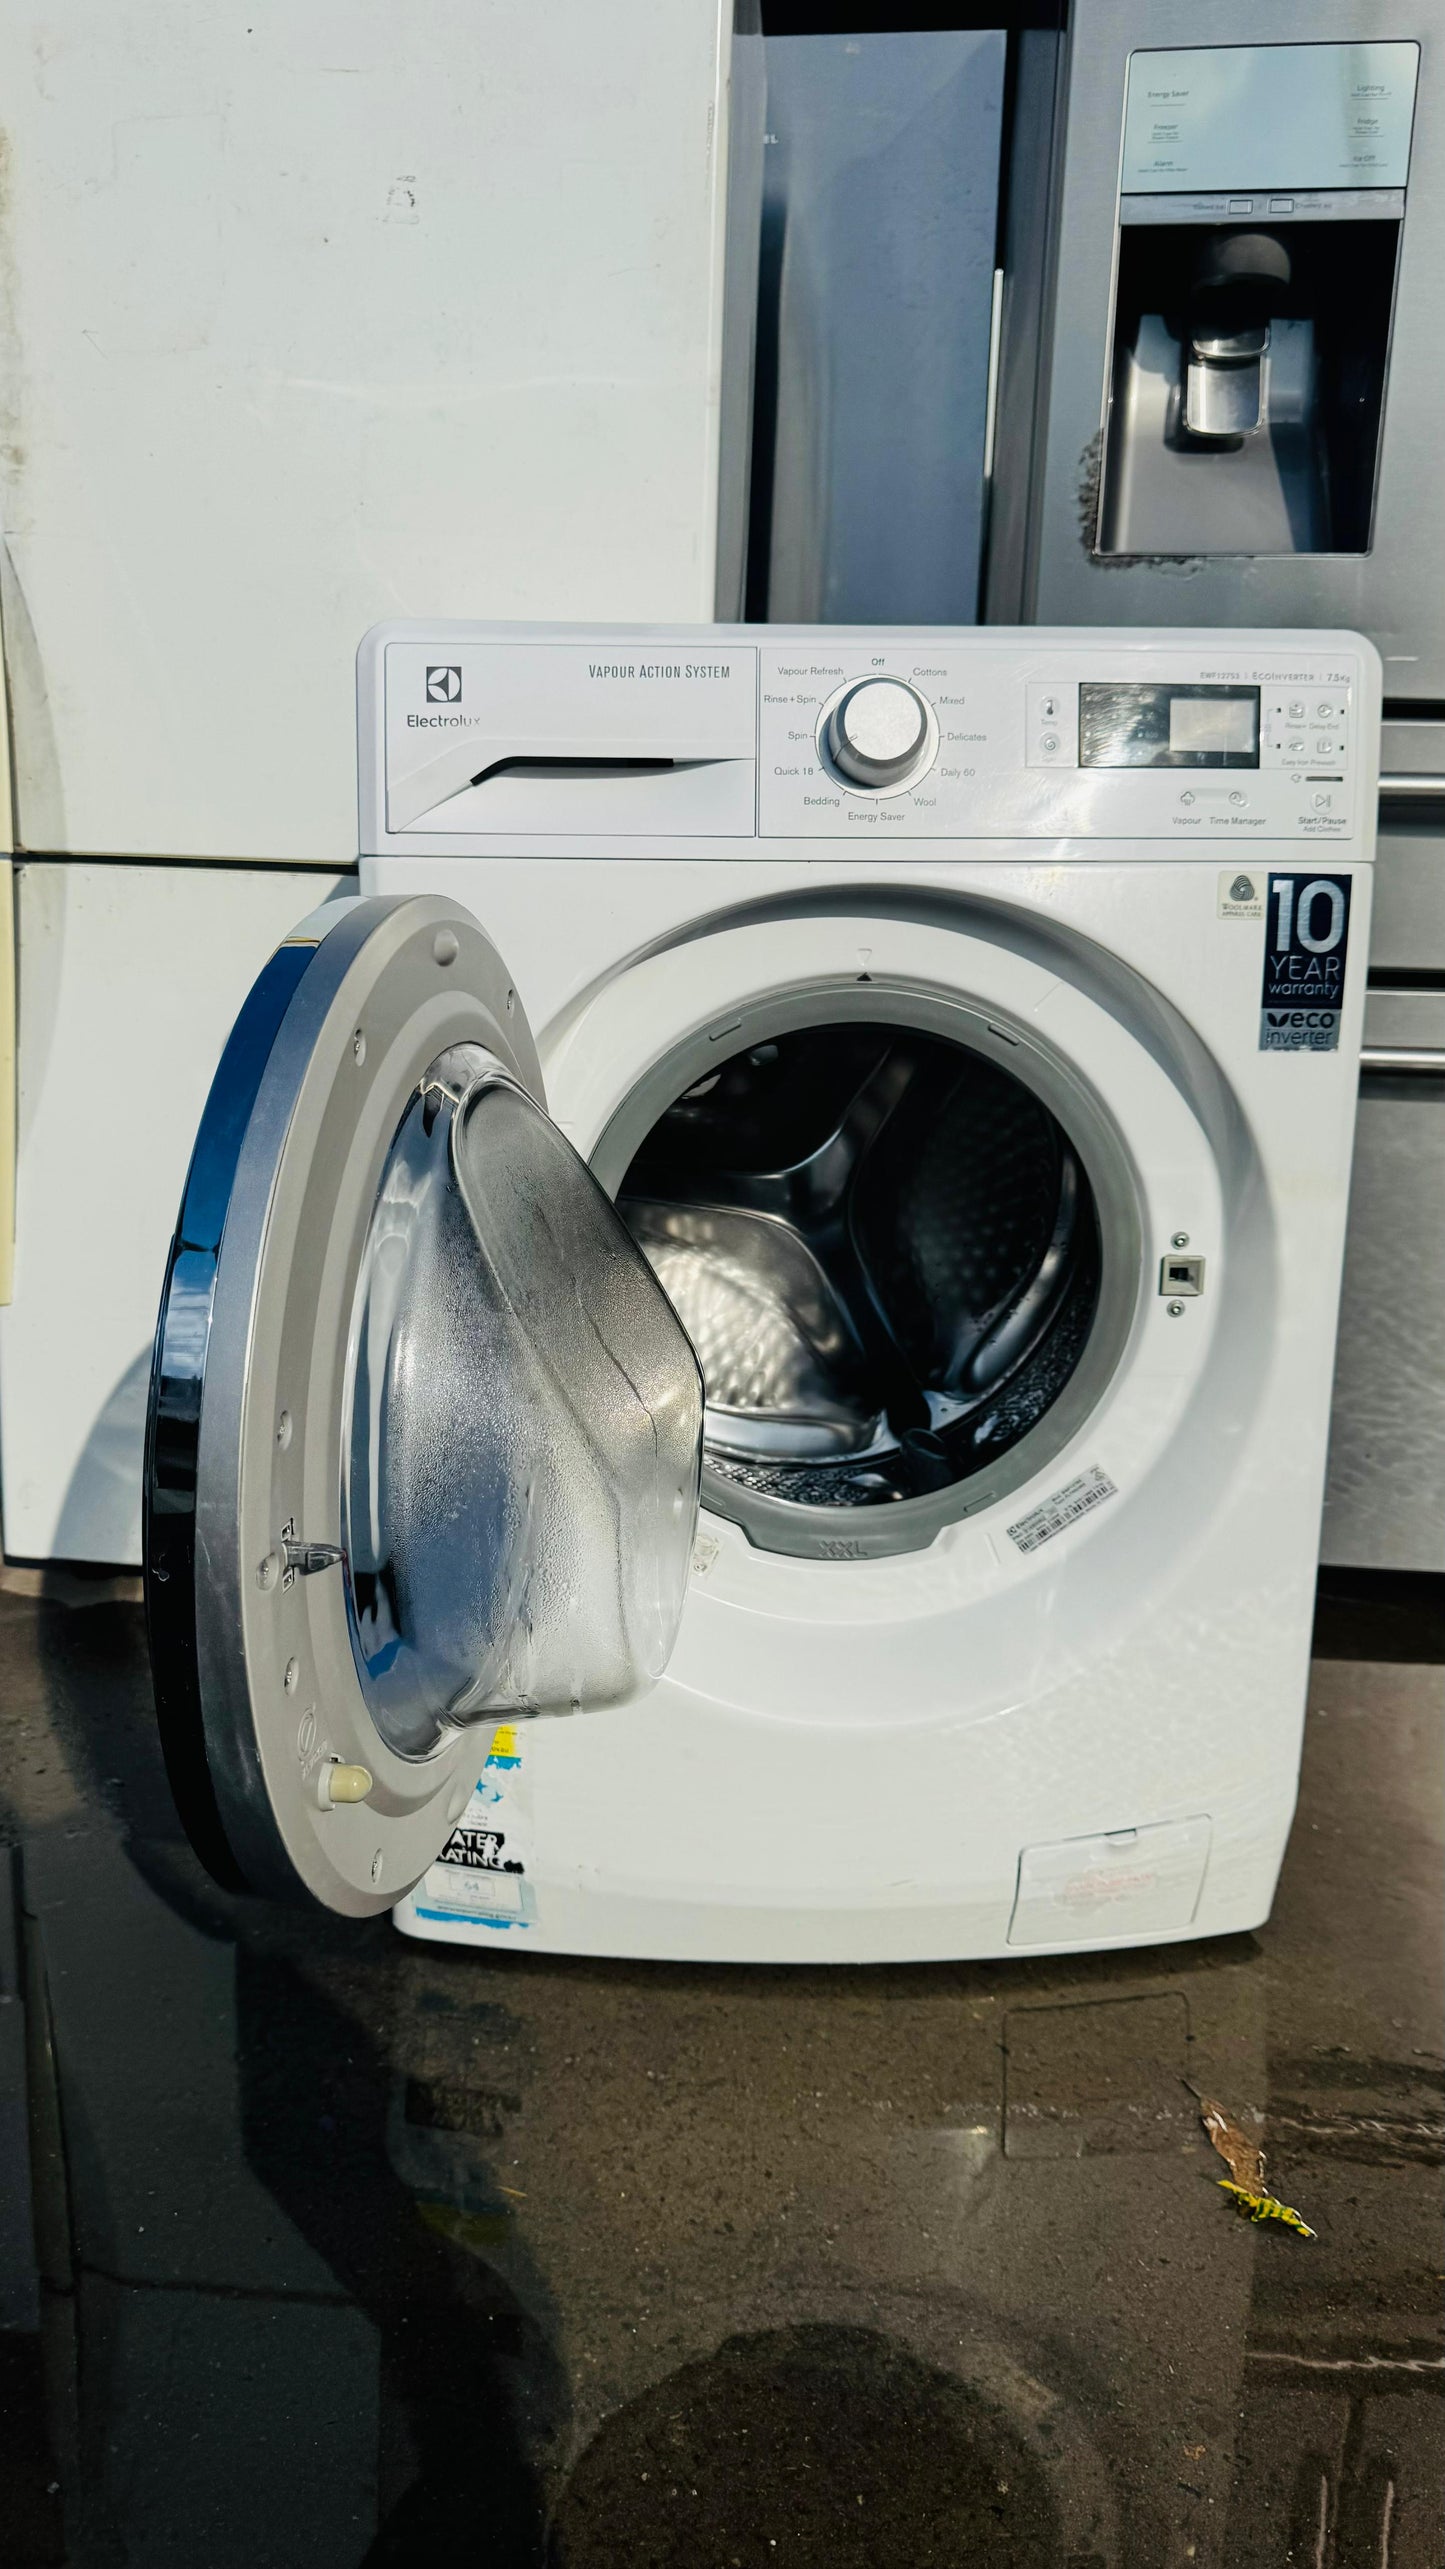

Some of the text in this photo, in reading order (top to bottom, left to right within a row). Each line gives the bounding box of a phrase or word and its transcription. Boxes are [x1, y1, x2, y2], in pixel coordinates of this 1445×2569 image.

[1357, 84, 1385, 92] Lighting
[1147, 91, 1170, 99] Energy
[871, 657, 885, 666] Off
[588, 664, 731, 680] VAPOUR ACTION SYSTEM
[778, 666, 844, 677] Vapour Refresh
[912, 667, 948, 677] Cottons
[764, 695, 788, 704] Rinse
[797, 695, 817, 706] Spin
[939, 696, 965, 705] Mixed
[406, 713, 481, 729] Electrolux
[788, 731, 808, 741] Spin
[947, 732, 987, 742] Delicates
[774, 767, 814, 776] Quick 18
[940, 768, 975, 778] Daily 60
[803, 797, 840, 807] Bedding
[913, 797, 937, 807] Wool
[848, 812, 905, 823] Energy Saver
[1172, 817, 1202, 825] Vapour
[1209, 817, 1266, 826] Time Manager
[1297, 816, 1347, 825] Start/Pause
[1272, 879, 1345, 954] 10
[1270, 955, 1340, 981] YEAR
[1268, 983, 1340, 1000] warranty
[1290, 1012, 1335, 1029] eco
[1266, 1028, 1333, 1045] inverter
[819, 1540, 868, 1559] XXL
[450, 1829, 501, 1852] ATER
[440, 1847, 503, 1869] ATING
